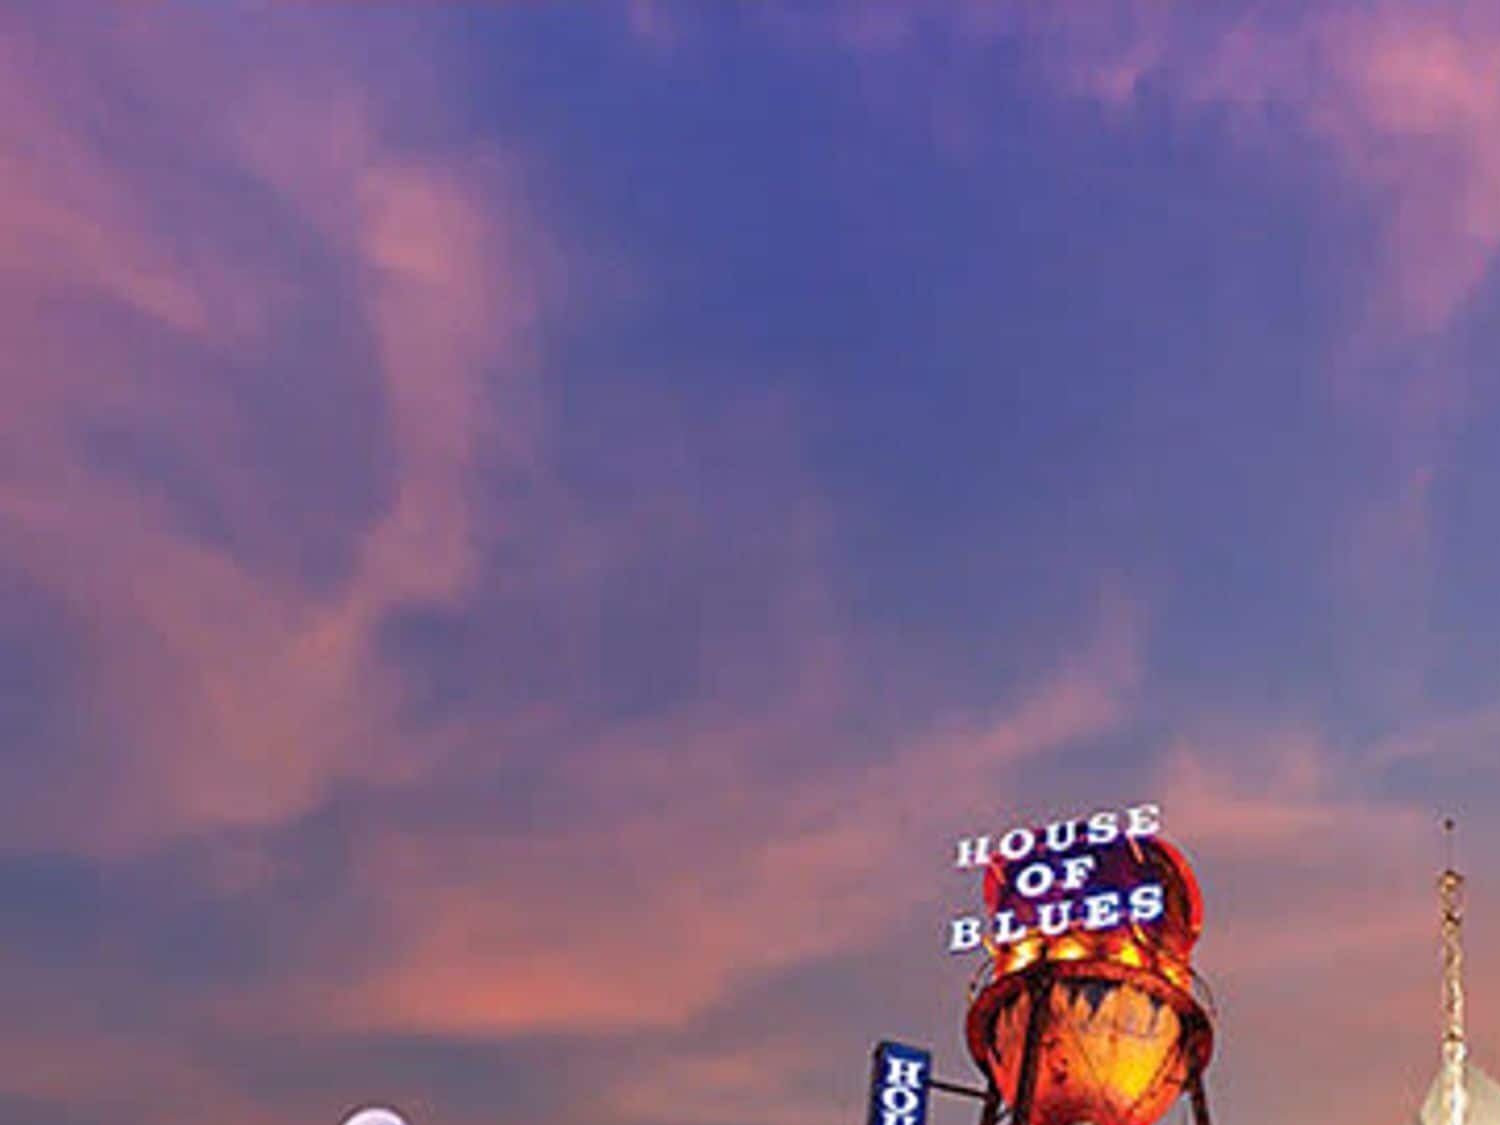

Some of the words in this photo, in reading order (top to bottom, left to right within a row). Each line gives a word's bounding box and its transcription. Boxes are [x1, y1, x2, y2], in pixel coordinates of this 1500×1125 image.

[956, 804, 1161, 867] HOUSE
[1016, 855, 1095, 897] OF
[950, 884, 1165, 951] BLUES
